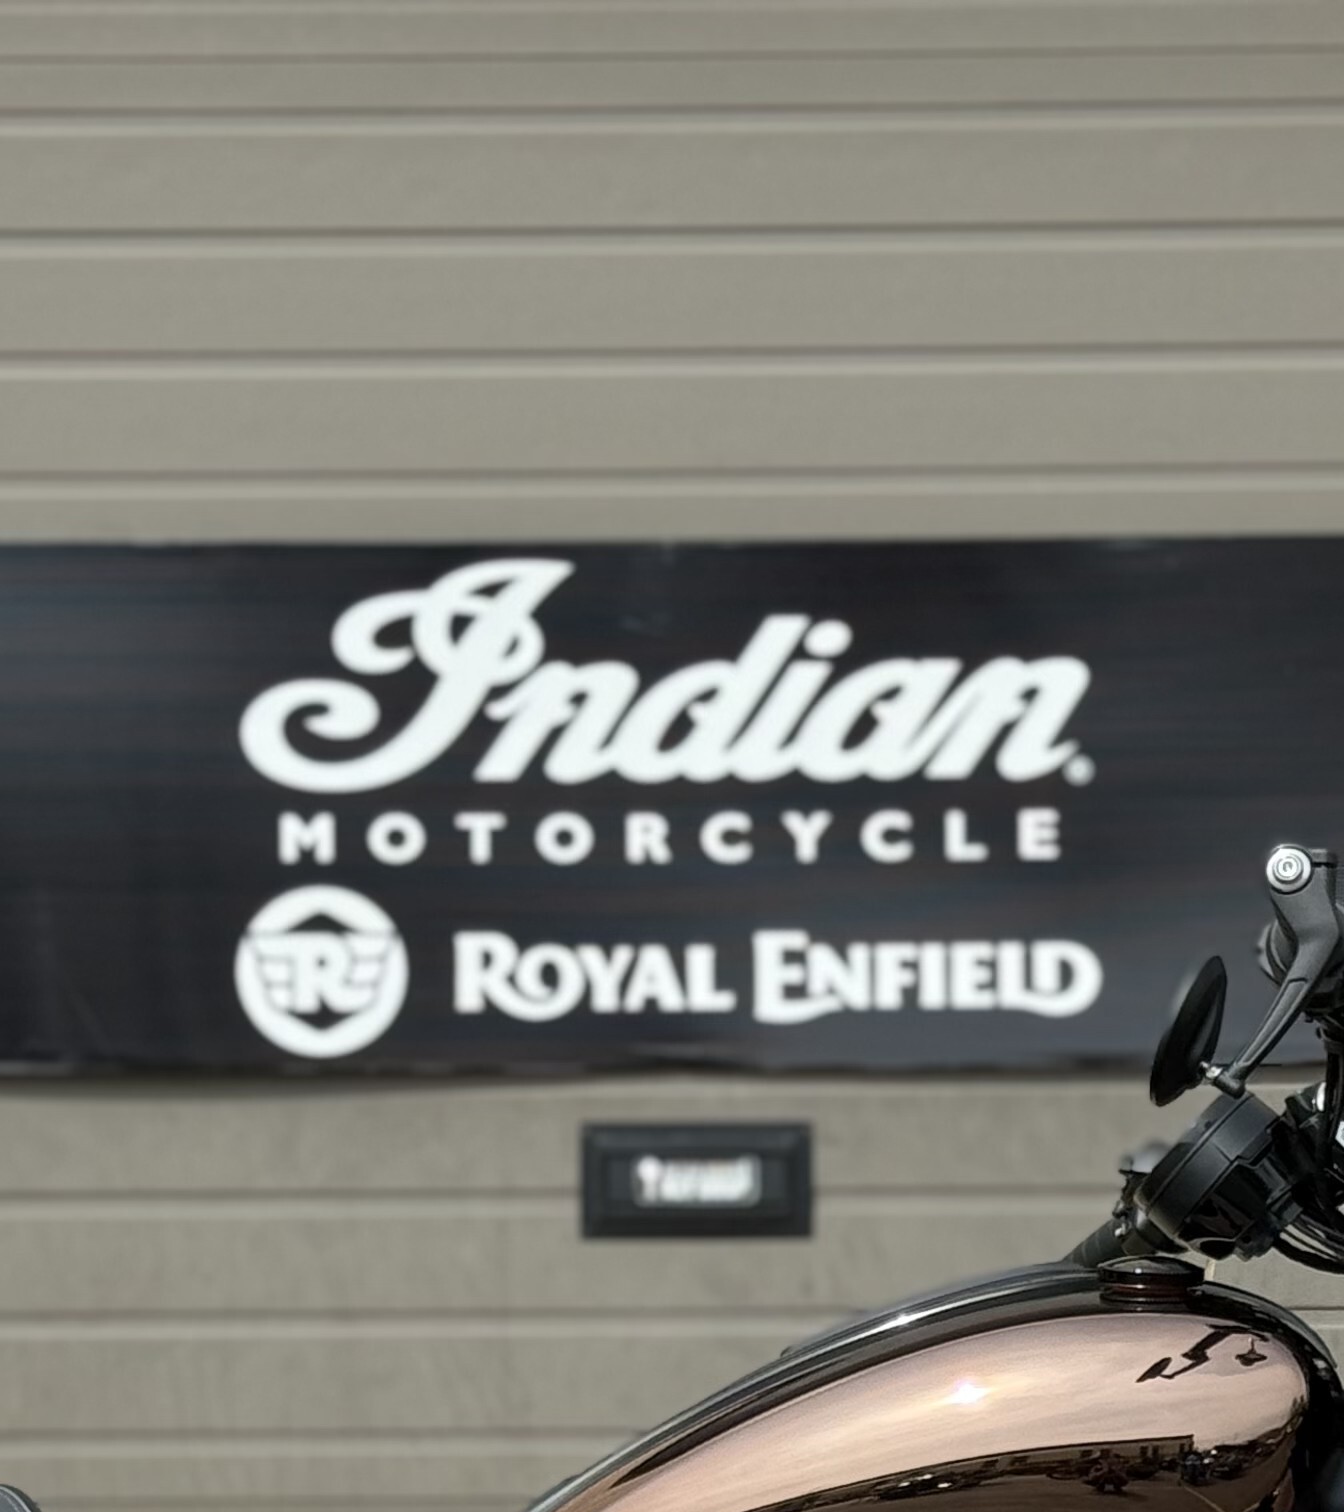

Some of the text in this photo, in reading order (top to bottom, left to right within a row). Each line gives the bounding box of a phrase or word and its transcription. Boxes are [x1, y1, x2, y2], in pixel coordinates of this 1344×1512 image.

[240, 557, 1089, 792] Indian
[278, 808, 1061, 864] MOTORCYCLE
[453, 929, 1103, 1023] ROYAL ENFIELD
